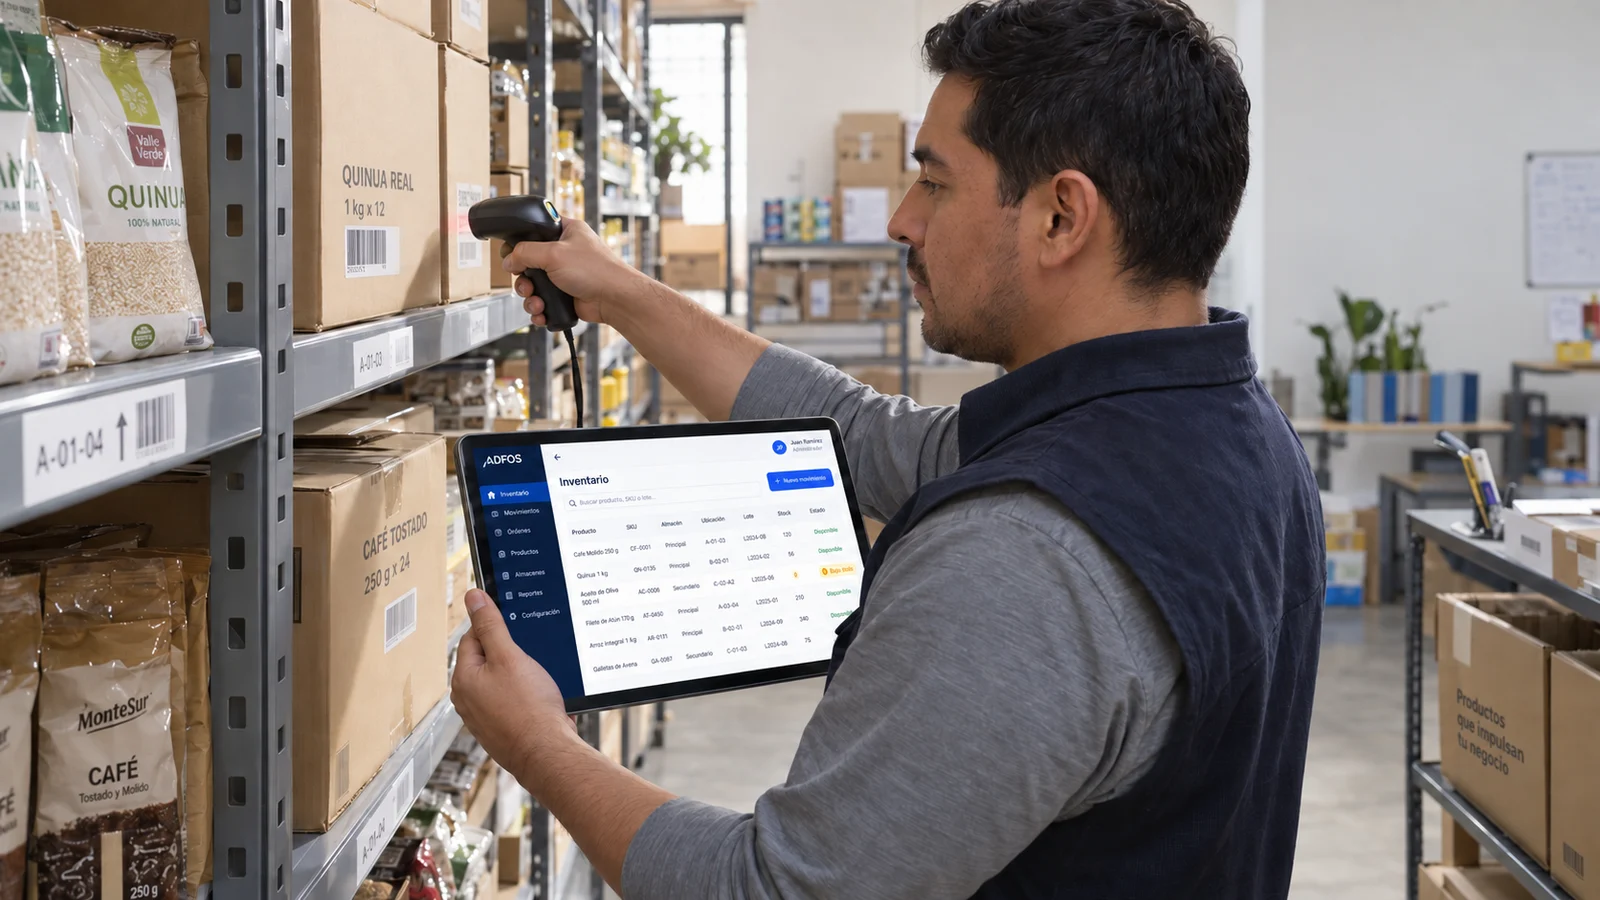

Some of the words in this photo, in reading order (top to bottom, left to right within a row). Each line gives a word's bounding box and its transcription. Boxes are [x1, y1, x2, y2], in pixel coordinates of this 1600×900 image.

[136, 134, 160, 147] Valle
[136, 147, 163, 160] Verde
[342, 164, 387, 188] QUINUA
[390, 171, 414, 191] REAL
[107, 184, 186, 211] QUINUA
[345, 198, 350, 215] 1
[352, 198, 364, 220] kg
[366, 204, 372, 216] x
[375, 201, 385, 216] 12
[127, 218, 150, 227] 100%
[152, 218, 181, 227] NATURAL
[360, 351, 383, 373] A-01-03
[35, 428, 103, 476] A-01-04
[483, 454, 523, 468] ADFOS
[559, 475, 609, 487] Inventario
[503, 508, 540, 516] Movimientos
[363, 525, 388, 560] CAFÉ
[390, 512, 428, 546] TOSTADO
[364, 569, 382, 595] 250
[384, 567, 390, 587] g
[392, 563, 398, 577] x
[400, 552, 410, 573] 24
[515, 569, 545, 578] Almacenes
[518, 590, 543, 598] Reportes
[521, 608, 560, 618] Configuración
[677, 606, 699, 614] Principal
[77, 693, 150, 731] MonteSur
[1456, 687, 1506, 730] Productos
[1457, 713, 1475, 734] que
[1477, 720, 1525, 764] impulsan
[1457, 731, 1468, 750] tu
[1469, 742, 1510, 775] negocio
[88, 754, 139, 786] CAFÉ
[79, 789, 113, 804] Tostado
[115, 790, 120, 800] y
[122, 782, 149, 797] Molido
[130, 884, 150, 899] 250
[151, 885, 158, 898] g
